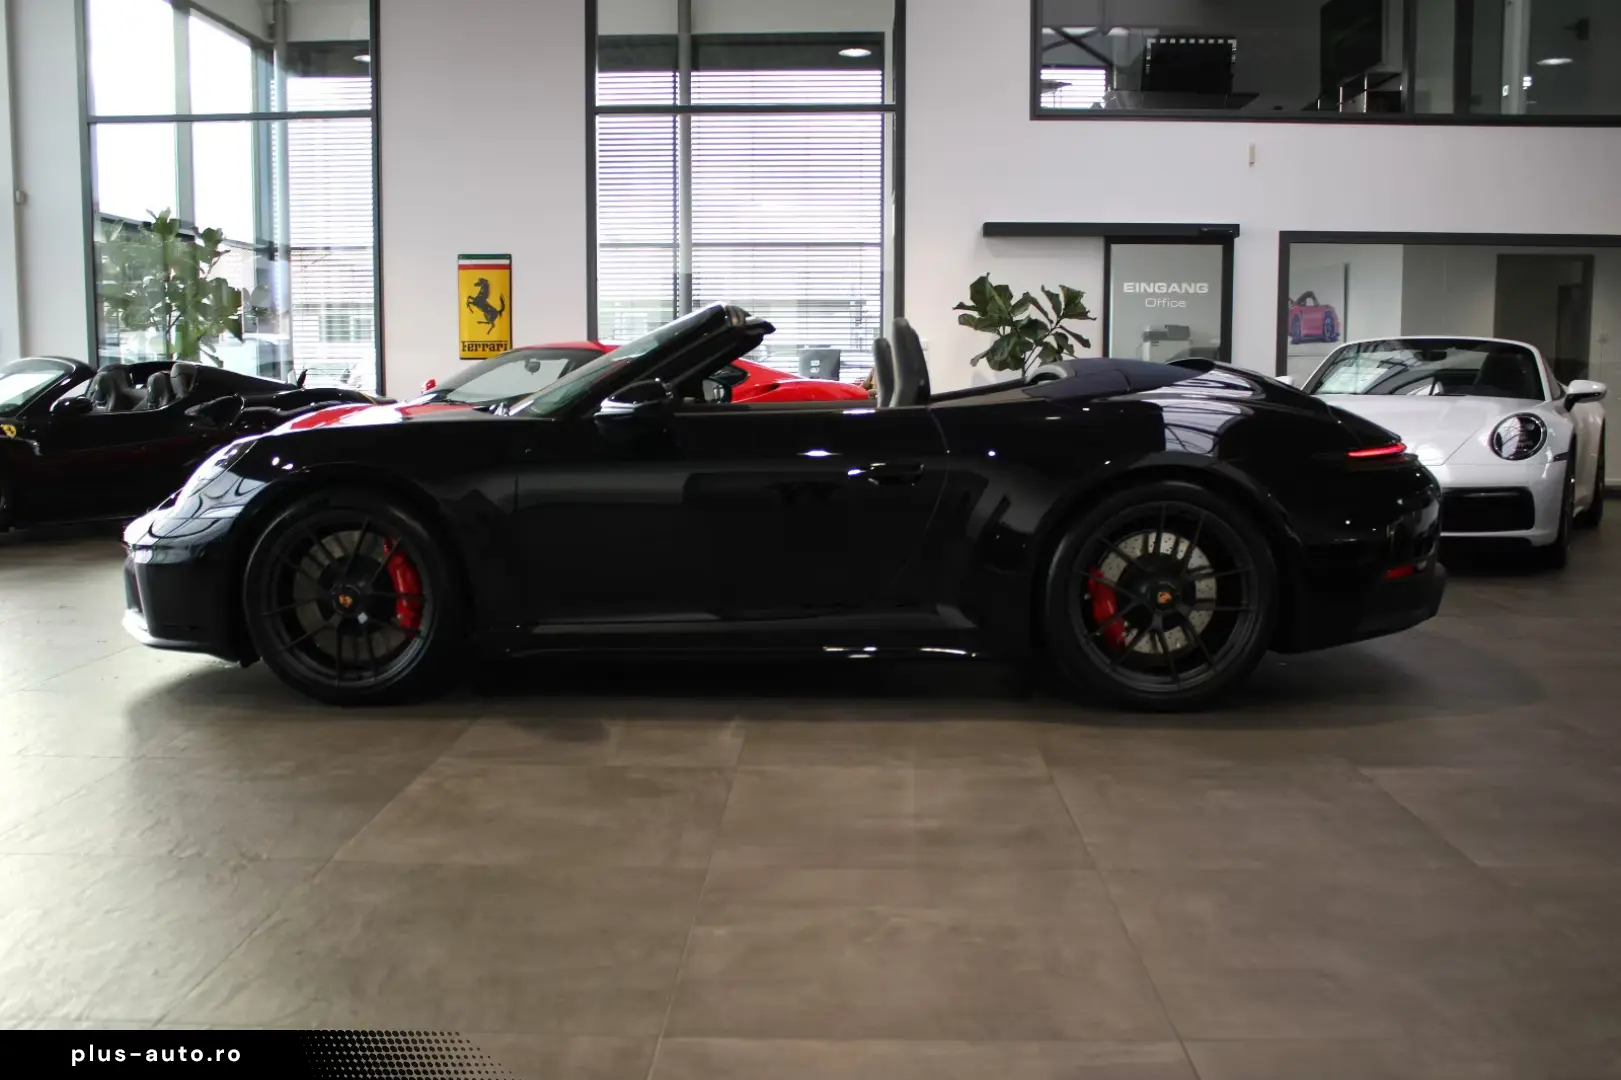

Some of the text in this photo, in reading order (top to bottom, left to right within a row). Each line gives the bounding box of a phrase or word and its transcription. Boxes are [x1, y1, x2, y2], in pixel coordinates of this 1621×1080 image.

[1123, 282, 1209, 294] EINGANG
[1145, 297, 1186, 308] Office
[461, 340, 508, 352] Ferrari
